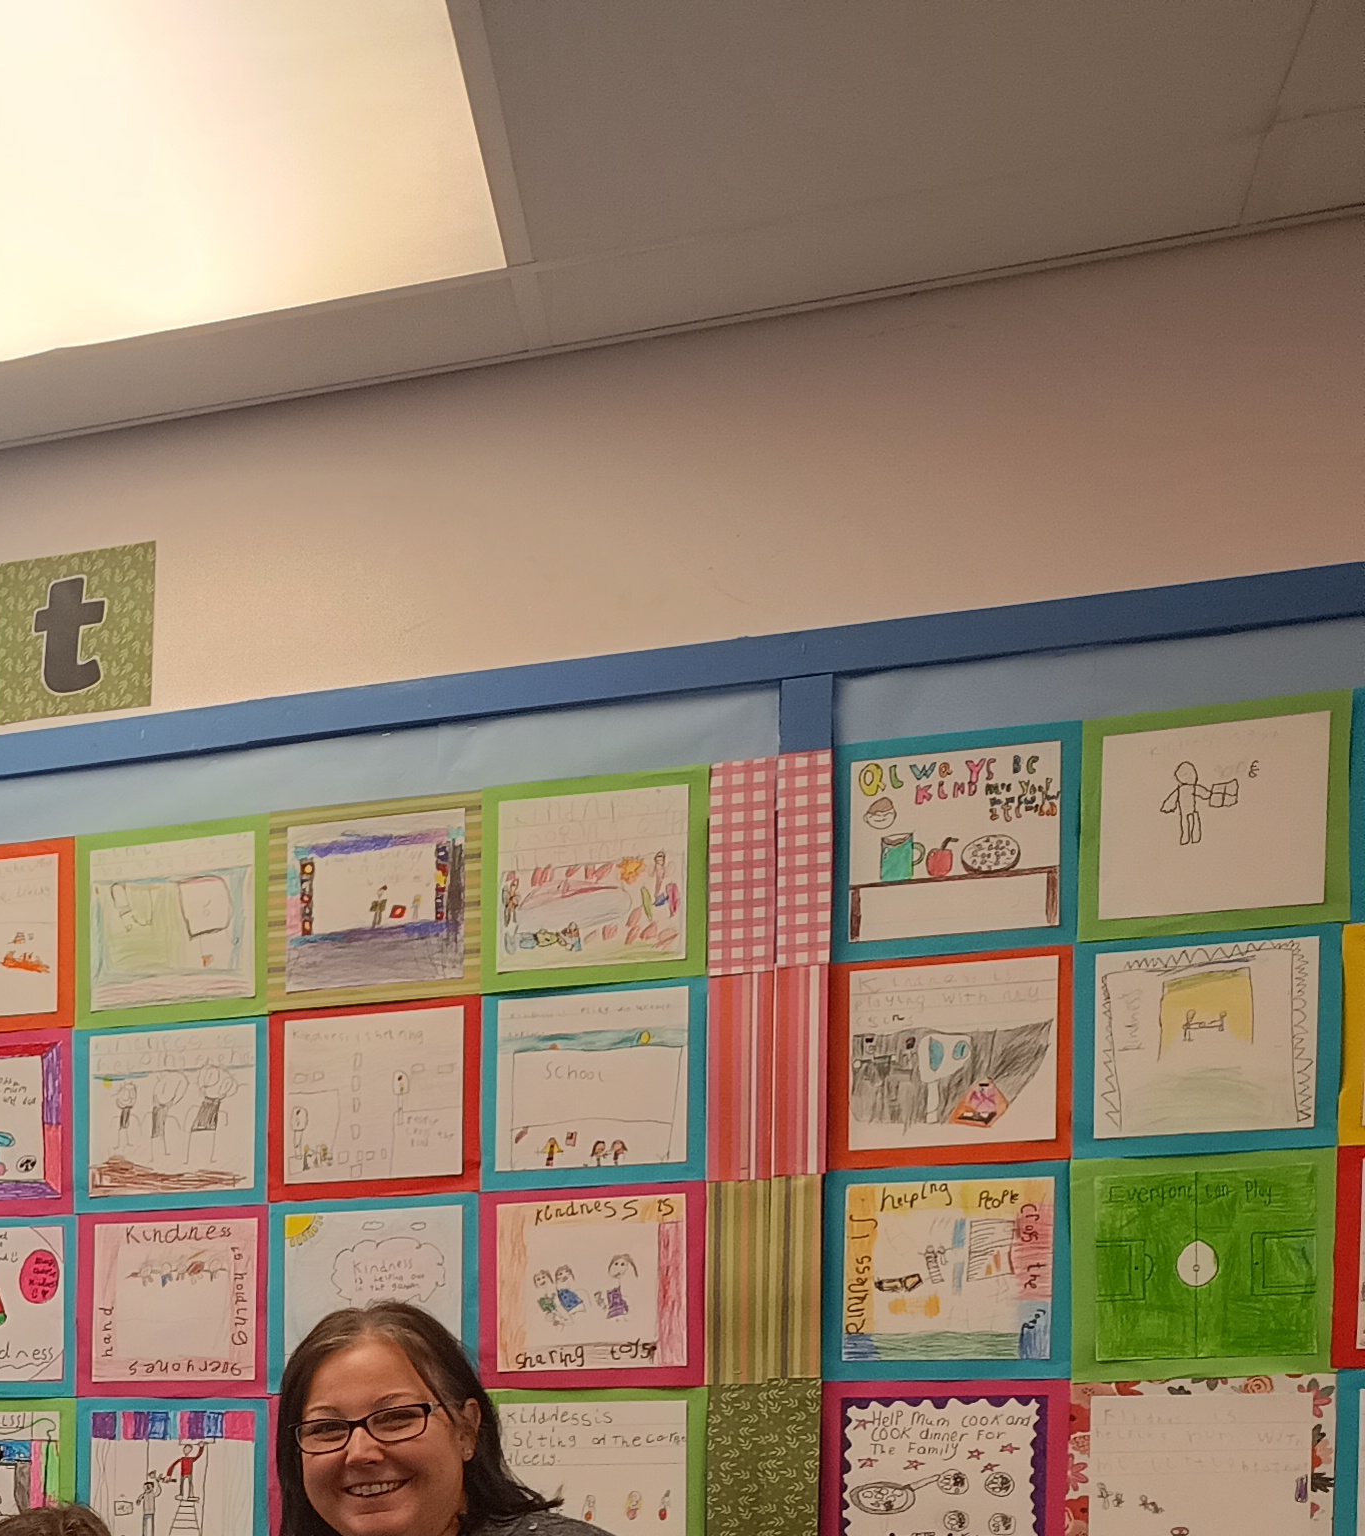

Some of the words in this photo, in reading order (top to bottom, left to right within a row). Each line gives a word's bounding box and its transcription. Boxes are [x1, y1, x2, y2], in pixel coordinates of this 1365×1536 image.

[1108, 1182, 1195, 1207] Everyone
[125, 1223, 233, 1246] Kindness
[98, 1306, 116, 1359] hand
[1007, 1413, 1031, 1427] and
[918, 1427, 969, 1443] dinner
